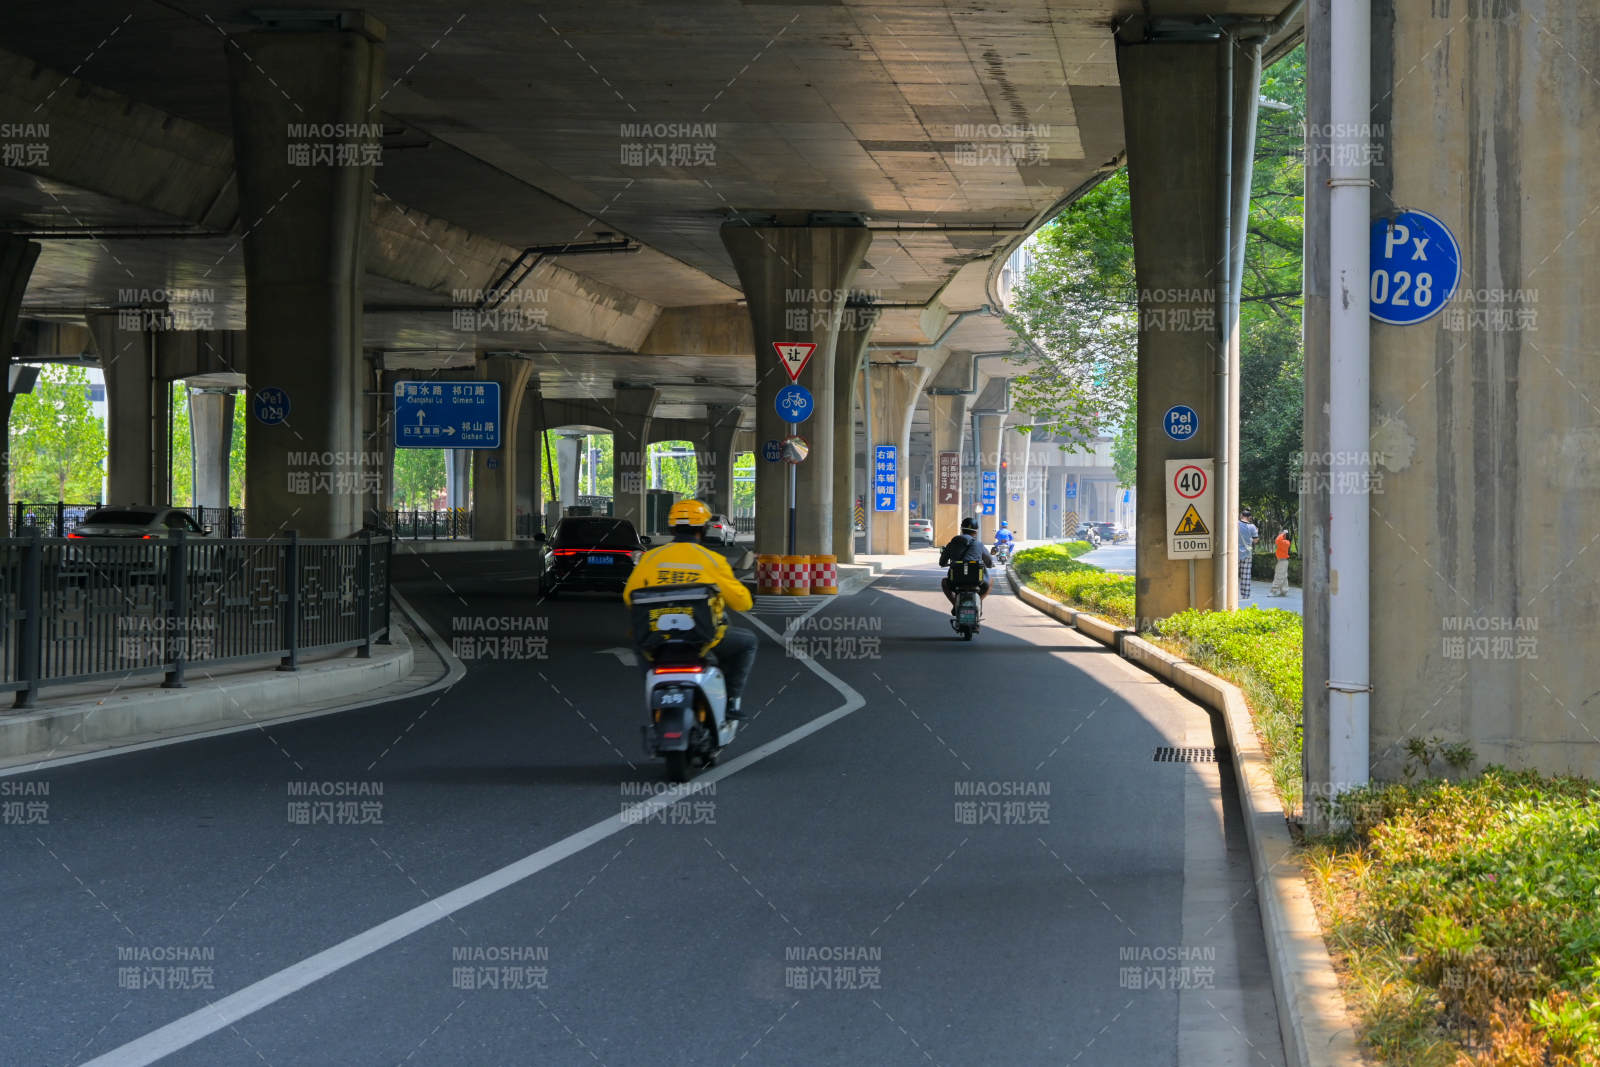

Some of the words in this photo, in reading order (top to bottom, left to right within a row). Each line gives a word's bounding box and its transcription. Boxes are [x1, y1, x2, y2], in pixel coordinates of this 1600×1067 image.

[1385, 224, 1430, 261] Px
[1370, 269, 1433, 307] 028
[788, 348, 801, 362] 让
[452, 397, 474, 405] Qimen
[476, 397, 485, 405] Lu
[261, 407, 283, 420] 029
[462, 421, 495, 432] 祁山路
[1170, 424, 1192, 436] 029
[486, 433, 495, 441] Lu
[1180, 472, 1202, 493] 40
[1176, 540, 1208, 550] 100m
